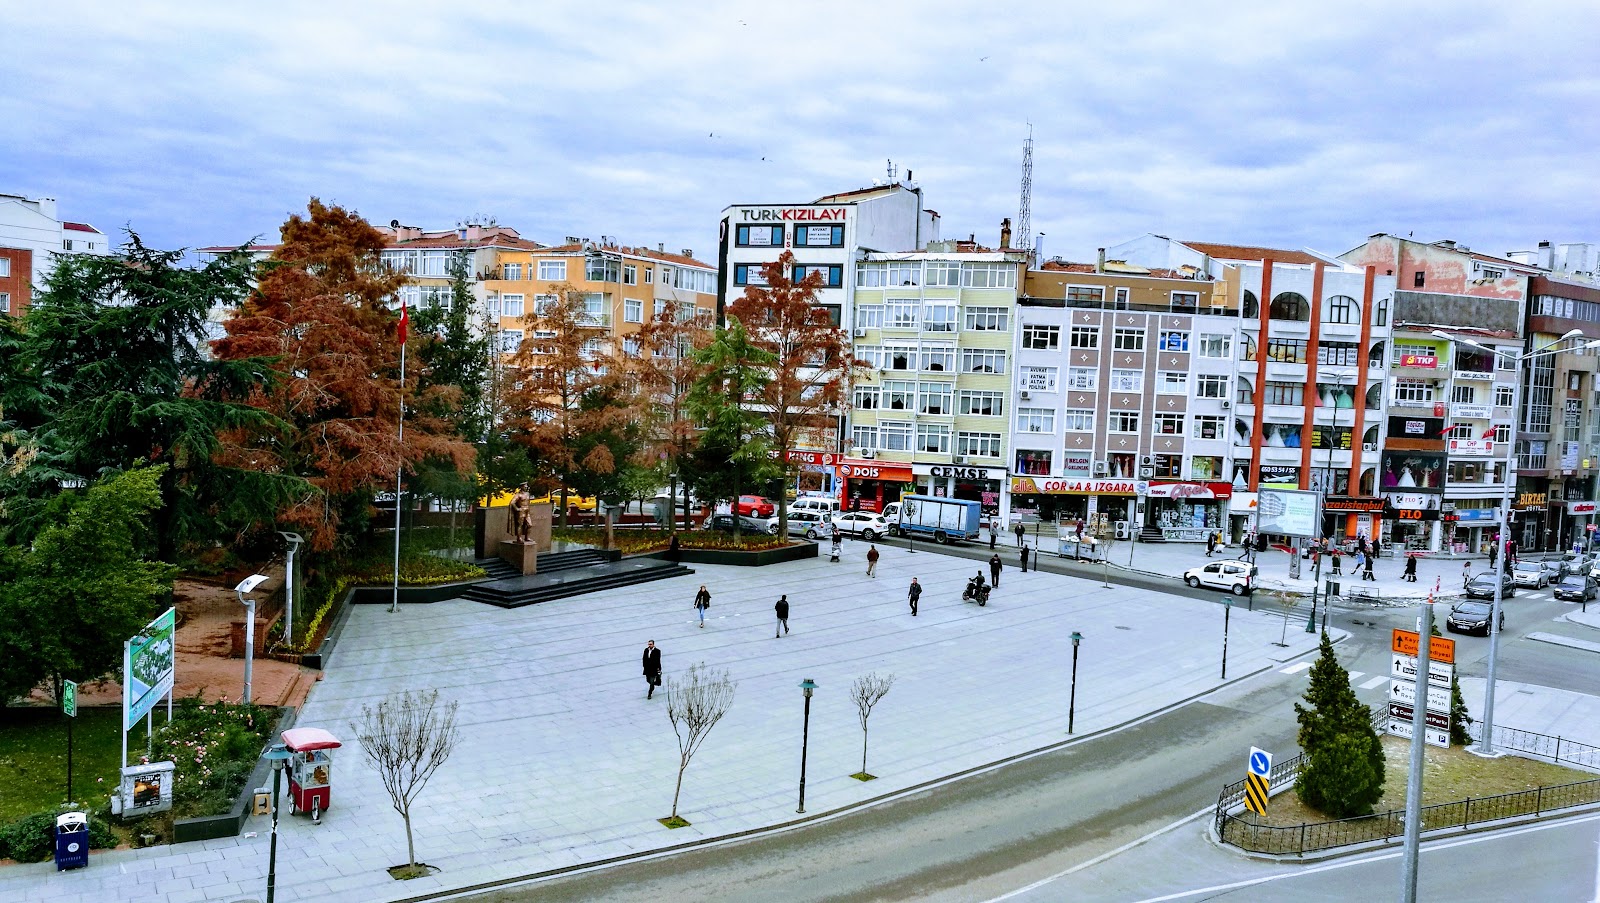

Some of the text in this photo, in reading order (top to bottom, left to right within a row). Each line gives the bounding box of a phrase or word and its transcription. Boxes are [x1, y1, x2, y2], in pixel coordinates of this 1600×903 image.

[1417, 357, 1434, 365] TKP
[1566, 402, 1577, 412] LG
[1045, 481, 1082, 494] ÇORA
[1084, 483, 1092, 491] &
[1399, 509, 1422, 520] FLO
